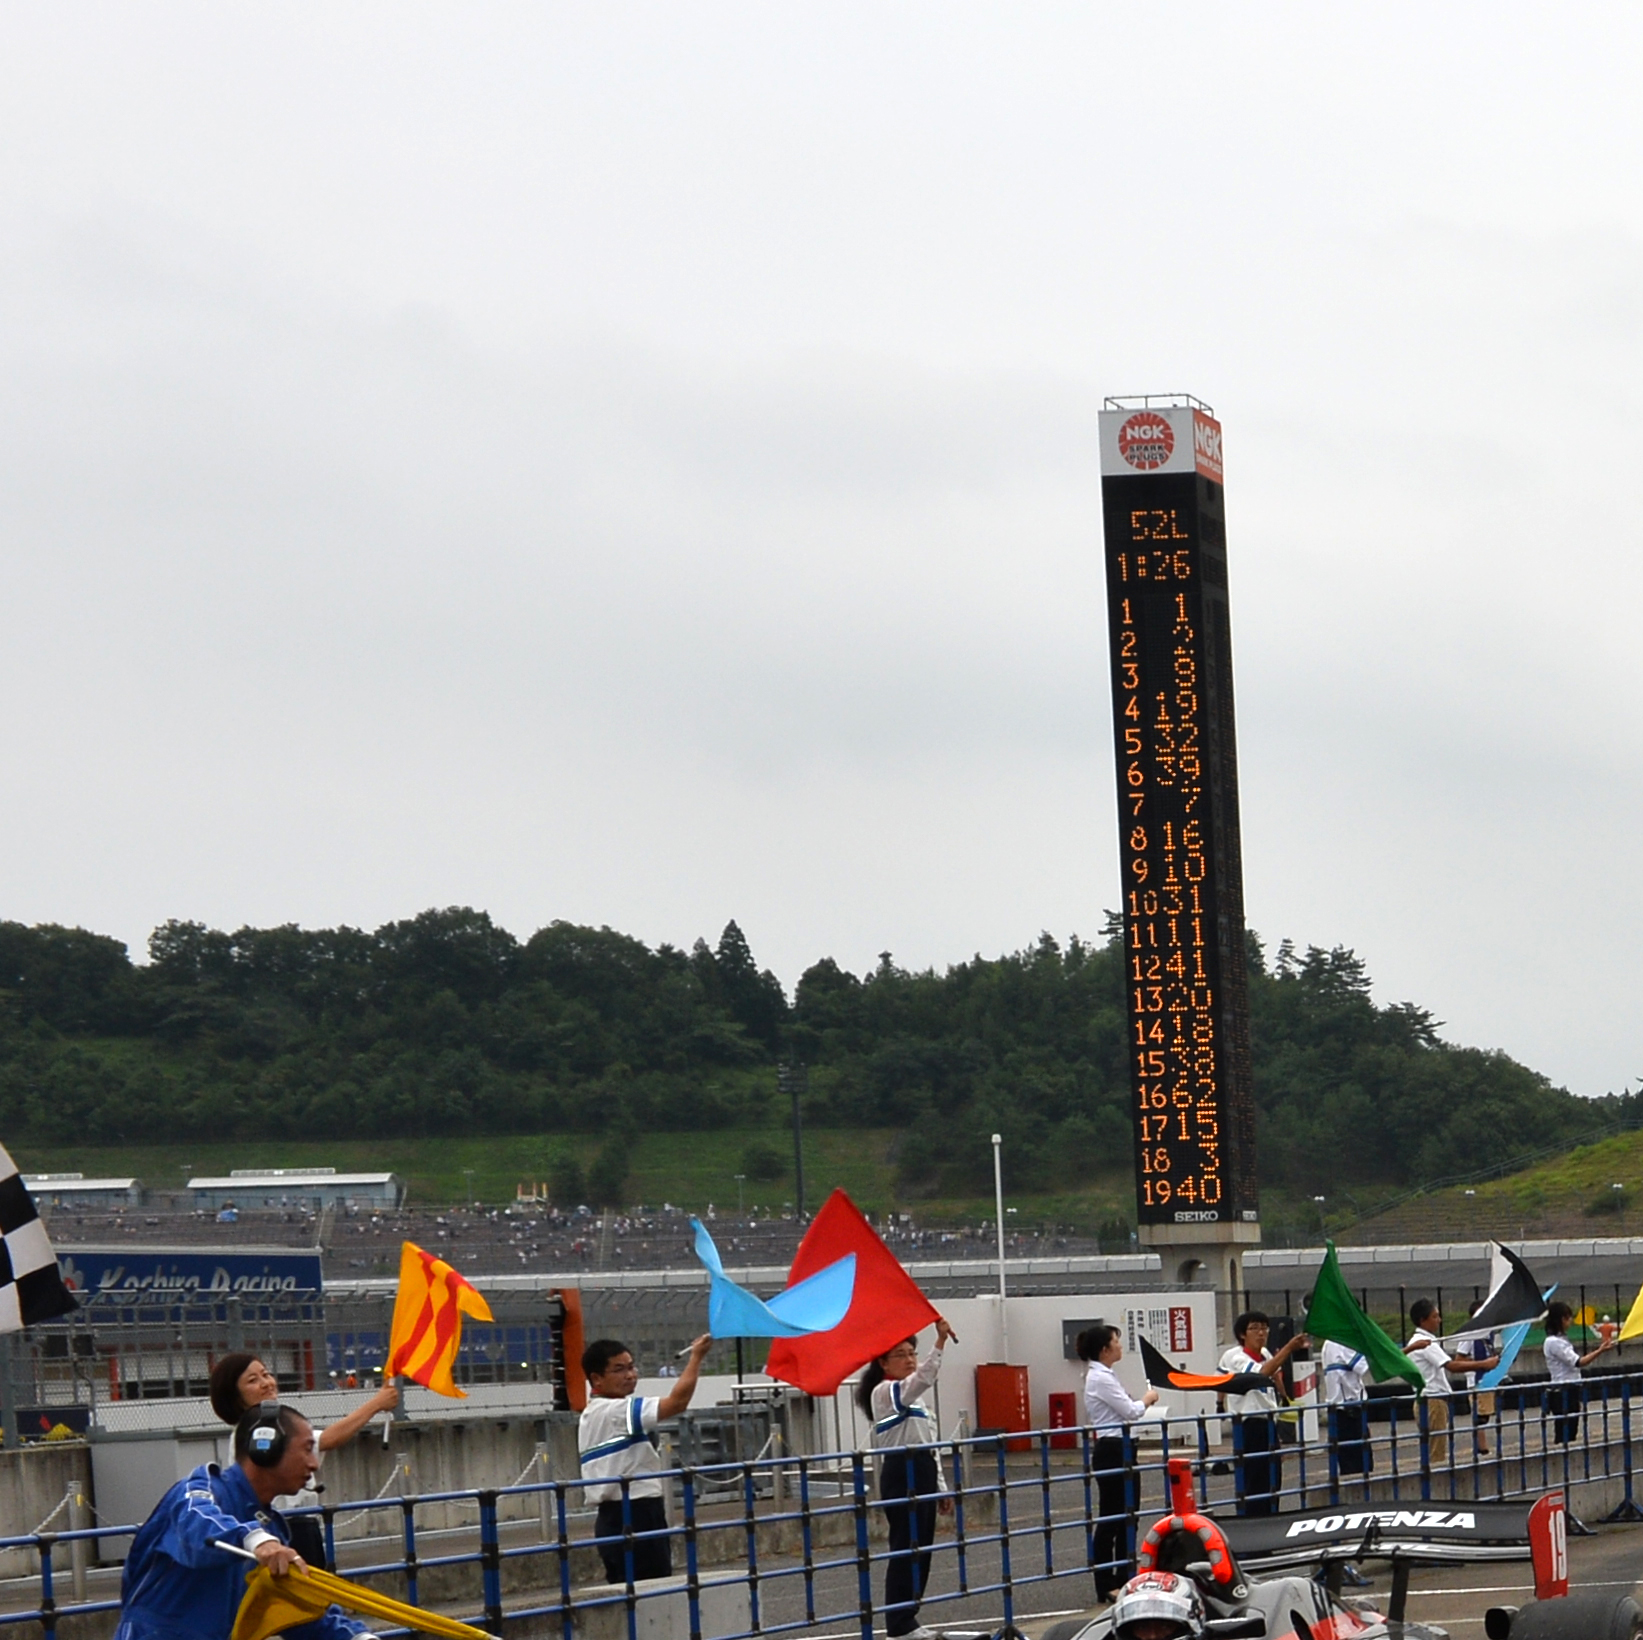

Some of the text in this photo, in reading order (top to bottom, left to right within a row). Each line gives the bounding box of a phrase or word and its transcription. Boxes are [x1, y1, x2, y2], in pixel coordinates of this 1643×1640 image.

[1126, 425, 1164, 440] NGK
[1195, 421, 1222, 461] NGK
[1129, 453, 1165, 461] PLUGS
[1131, 510, 1188, 540] 52L
[1118, 550, 1190, 581] 1:26
[1122, 592, 1189, 624] 1 1
[1121, 631, 1137, 657] 2
[1122, 657, 1196, 689] 3 8
[1124, 690, 1198, 721] 4 19
[1125, 722, 1199, 755] 5 32
[1127, 755, 1201, 787] 6 39
[1128, 792, 1145, 816] 7
[1130, 819, 1204, 851] 8 16
[1132, 852, 1206, 883] 9 10
[1128, 884, 1204, 917] 10 31
[1130, 917, 1205, 949] 11 11
[1132, 949, 1207, 981] 12 41
[1134, 986, 1164, 1013] 13
[1135, 1018, 1165, 1046] 14
[1137, 1050, 1166, 1077] 15
[1138, 1078, 1217, 1110] 16 62
[1140, 1110, 1218, 1142] 17 15
[1142, 1142, 1220, 1174] 18 3
[1143, 1174, 1222, 1206] 19 40
[1175, 1210, 1218, 1222] SEIKO
[1286, 1511, 1476, 1538] POTENZA
[1548, 1515, 1568, 1581] 19
